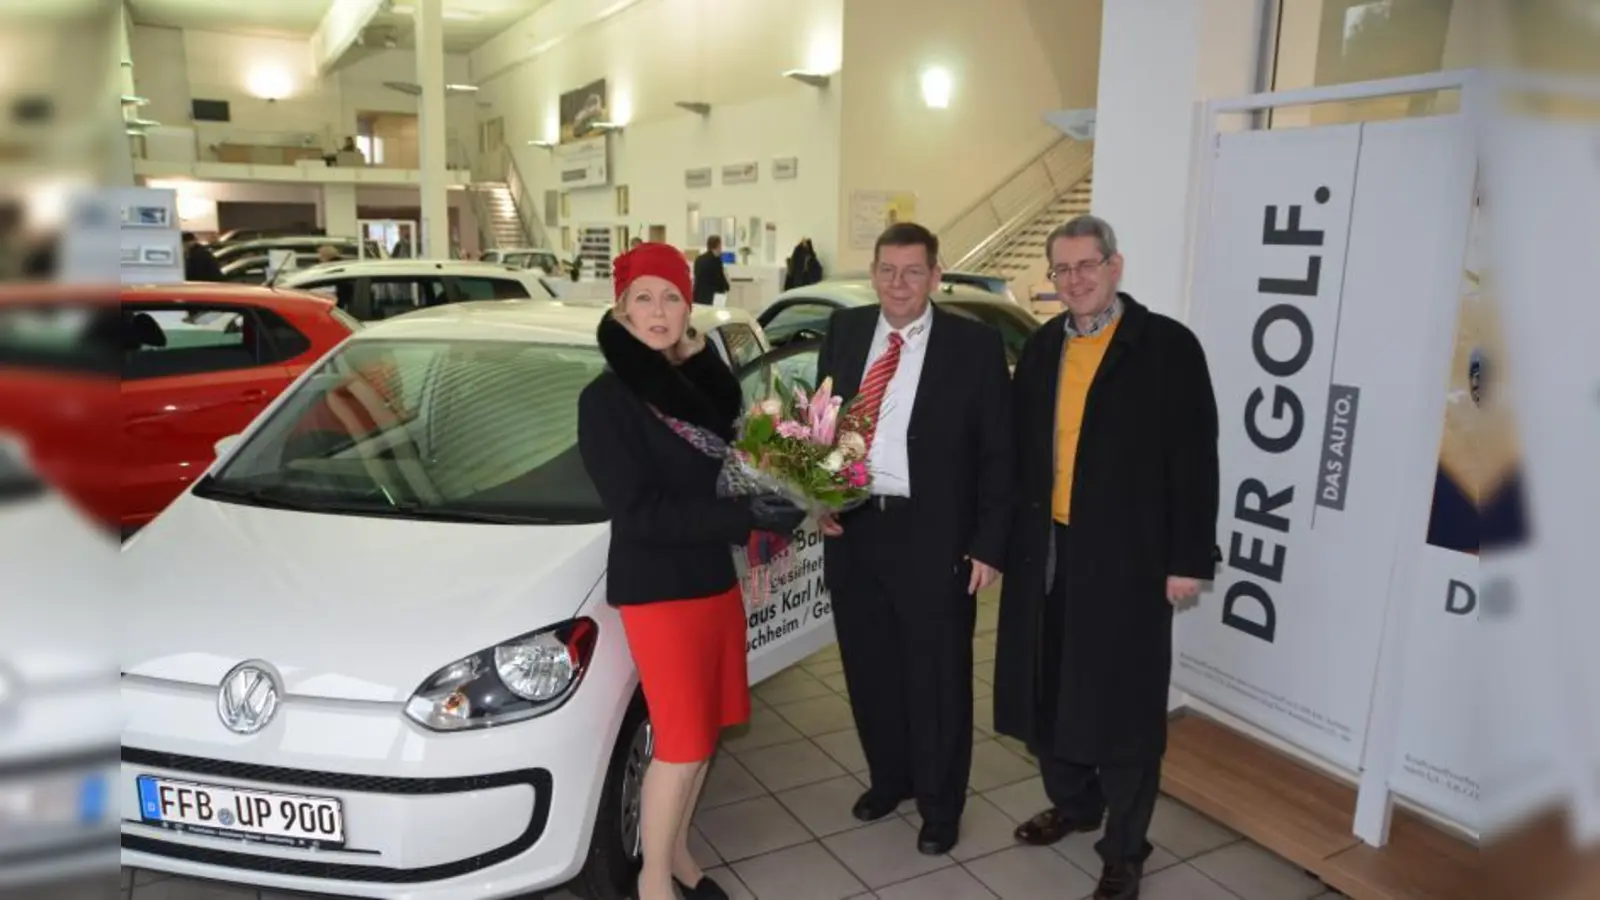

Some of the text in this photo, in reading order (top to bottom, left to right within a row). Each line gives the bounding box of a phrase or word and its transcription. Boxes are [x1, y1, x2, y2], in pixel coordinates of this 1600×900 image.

[1244, 185, 1331, 454] GOLF.
[1322, 393, 1353, 502] DAS AUTO.
[1221, 477, 1295, 644] DER
[746, 603, 776, 628] aus
[782, 578, 811, 613] Karl
[802, 605, 810, 626] /
[160, 786, 213, 820] FFB
[235, 796, 272, 827] UP
[280, 801, 335, 835] 900
